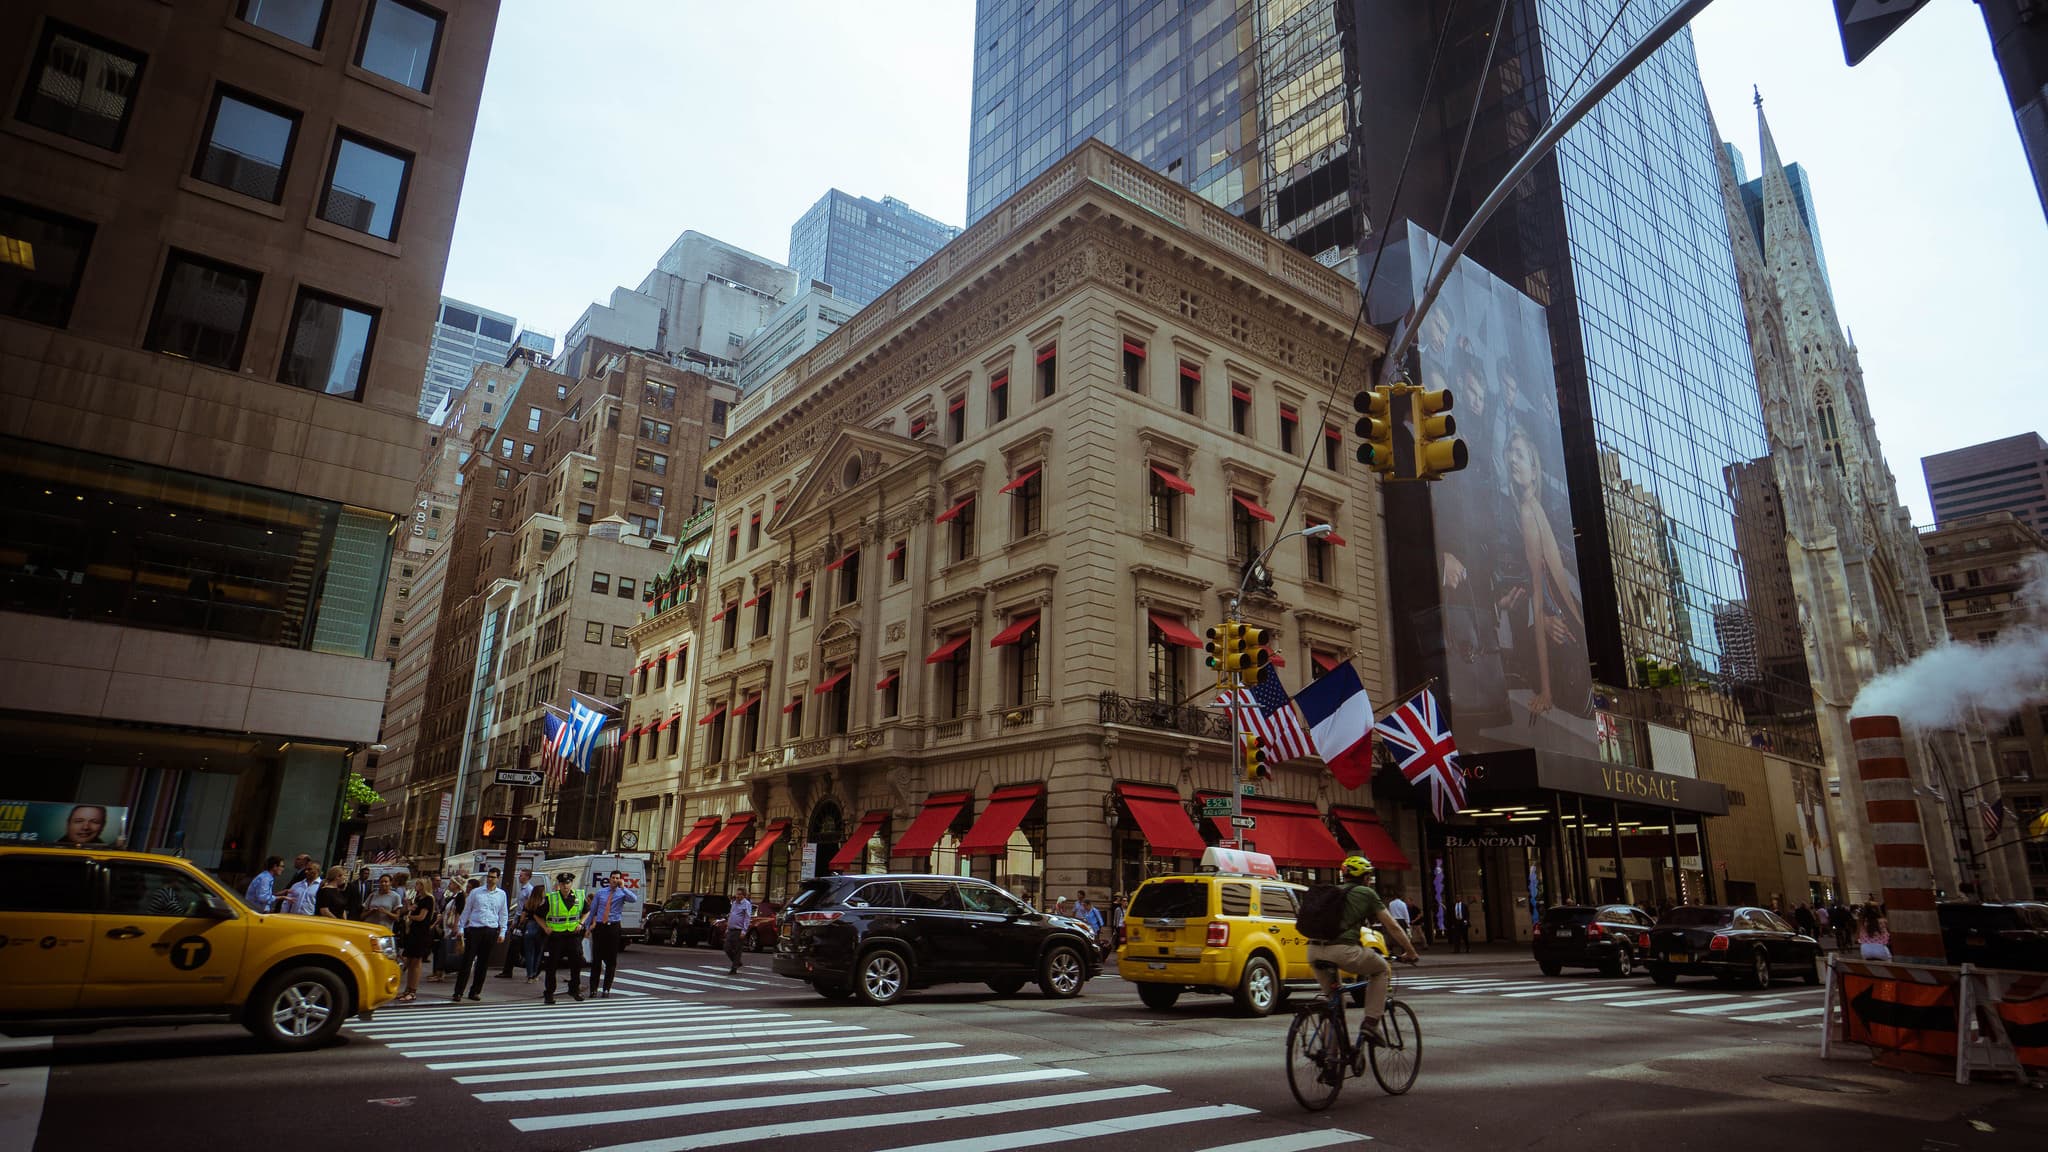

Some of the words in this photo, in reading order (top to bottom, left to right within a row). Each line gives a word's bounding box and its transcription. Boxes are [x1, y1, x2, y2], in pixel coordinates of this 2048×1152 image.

[414, 499, 428, 536] 485
[1601, 767, 1680, 802] VERSACE
[1446, 834, 1536, 847] BLANCPAIN
[592, 872, 640, 888] FeEx
[181, 942, 205, 966] T
